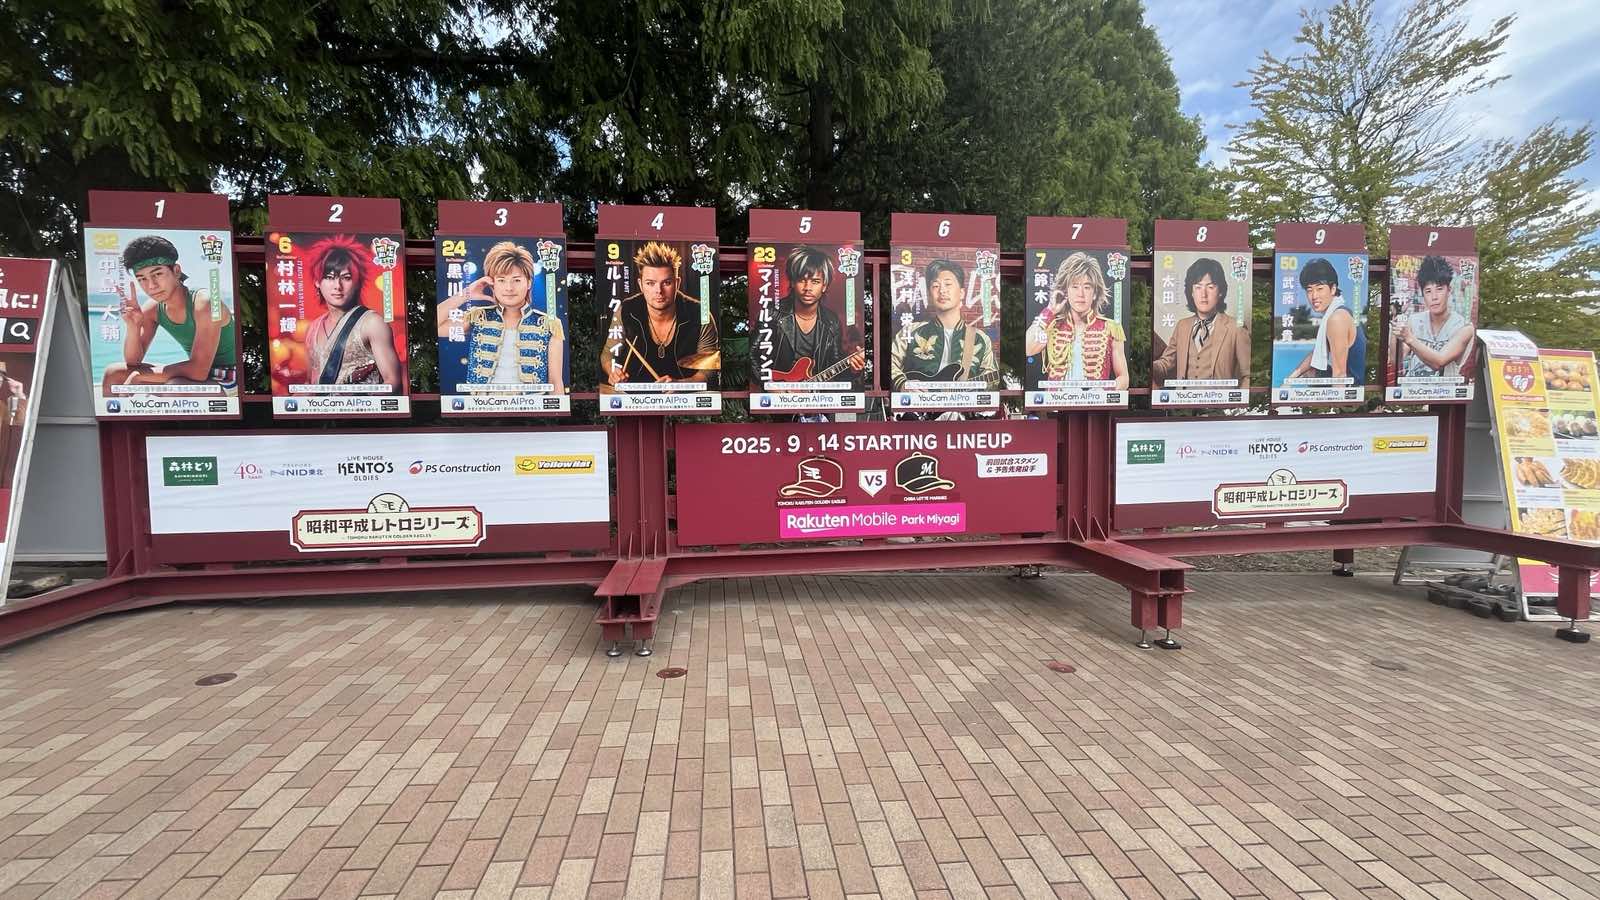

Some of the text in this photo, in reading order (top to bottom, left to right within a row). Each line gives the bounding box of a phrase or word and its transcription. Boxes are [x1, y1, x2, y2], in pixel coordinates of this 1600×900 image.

[154, 199, 165, 218] 1
[328, 203, 344, 222] 2
[494, 208, 508, 226] 3
[651, 212, 664, 230] 4
[799, 216, 812, 234] 5
[938, 220, 950, 237] 6
[1071, 223, 1083, 240] 7
[1196, 226, 1208, 242] 8
[278, 236, 292, 254] 6
[1314, 229, 1326, 245] 9
[1427, 231, 1439, 247] P
[442, 240, 466, 257] 24
[607, 243, 620, 260] 9
[754, 246, 776, 263] 23
[901, 249, 913, 265] 3
[1036, 252, 1047, 268] 7
[1163, 255, 1174, 269] 2
[1280, 256, 1298, 270] 50
[276, 260, 297, 333] 村林一輝
[131, 400, 170, 408] YouCam
[307, 399, 345, 407] YouCam
[779, 395, 810, 403] YouCam
[918, 394, 948, 402] YouCam
[843, 433, 938, 451] STARTING
[946, 432, 1012, 449] LINEUP
[1248, 443, 1288, 455] KENTO'S
[1309, 443, 1363, 452] PS Construction
[168, 461, 213, 472] 森林どり
[338, 462, 394, 476] KENTO'S
[425, 463, 501, 473] PS Construction
[864, 474, 883, 486] VS
[1223, 488, 1338, 504] 昭和平成レトロシリーズ
[306, 515, 470, 534] 昭和平成レトロシリーズ
[786, 512, 960, 530] Rakuten Mobile Park Miyagi
